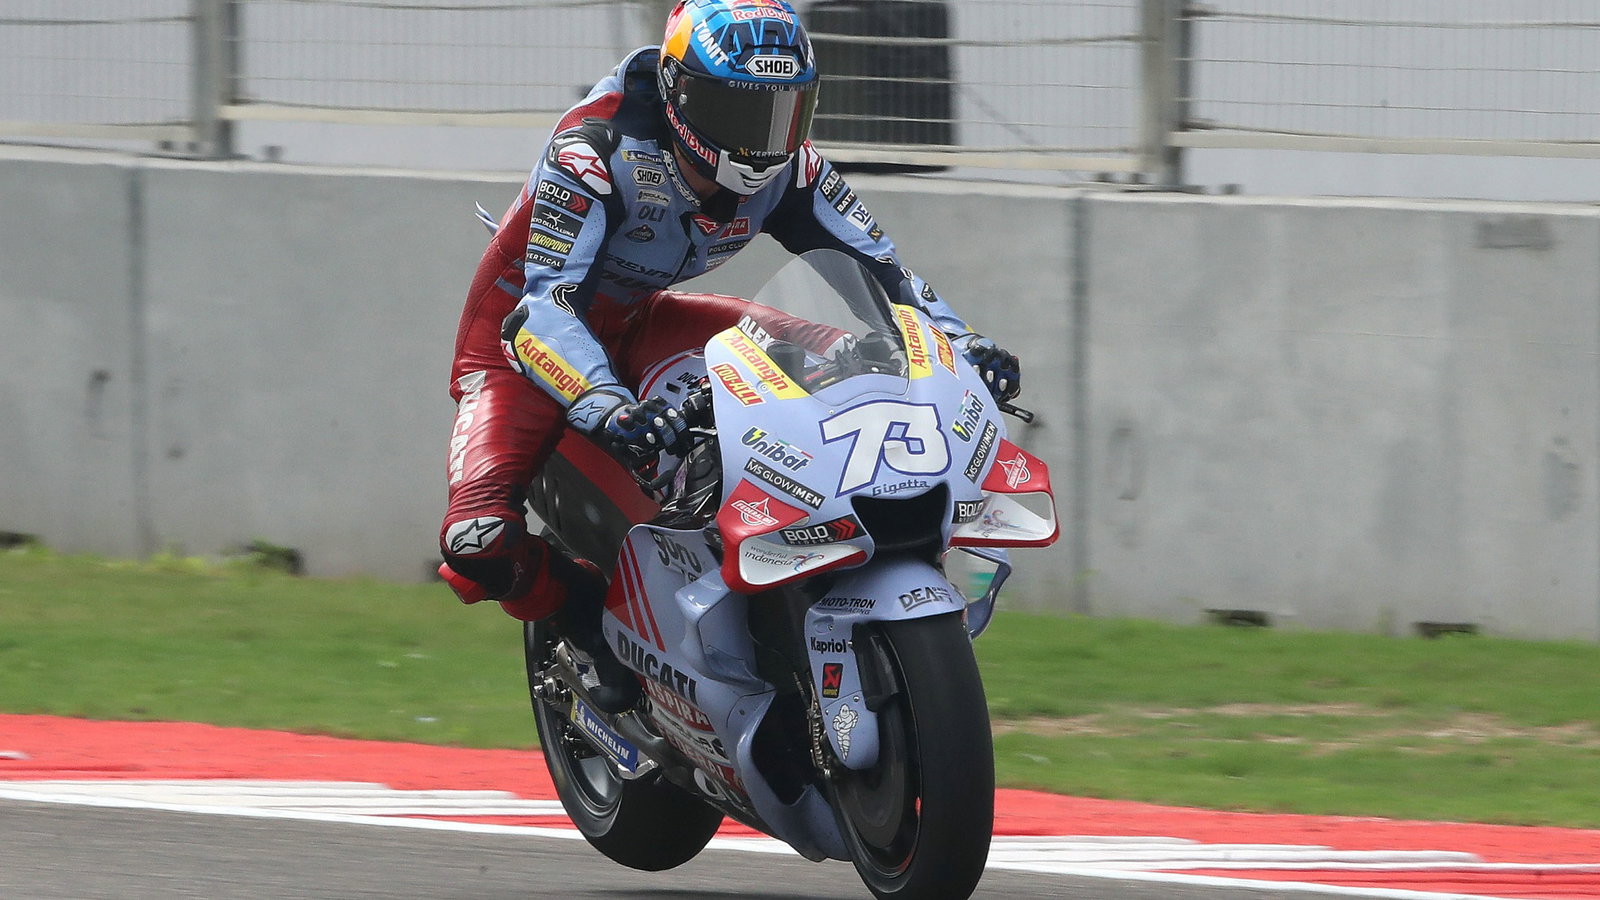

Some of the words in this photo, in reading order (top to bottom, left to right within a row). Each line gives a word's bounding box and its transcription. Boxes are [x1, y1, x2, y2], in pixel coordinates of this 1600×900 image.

[755, 60, 793, 75] SHOEI
[728, 80, 760, 91] GIVES
[764, 84, 784, 92] YOU
[665, 101, 688, 139] Red
[686, 131, 718, 167] Bull
[750, 149, 788, 158] VERTICAL
[637, 170, 661, 185] SHOEI
[821, 170, 840, 196] BOLD
[540, 181, 571, 201] BOLD
[727, 220, 747, 231] PIRA
[737, 315, 775, 351] ALEX
[898, 309, 928, 370] Antangin
[516, 337, 587, 397] Antangin
[725, 335, 788, 391] Antangin
[952, 392, 986, 442] Unibat
[741, 426, 810, 471] Unibat
[818, 398, 953, 499] 73
[872, 479, 931, 497] Gigetta
[736, 502, 763, 521] FEDERAL
[784, 525, 829, 541] BOLD
[750, 545, 788, 560] wonderful
[819, 597, 876, 609] MOTO-TRON
[810, 636, 848, 654] Kapriol
[616, 629, 698, 707] DUCATI
[586, 717, 631, 761] MICHELIN
